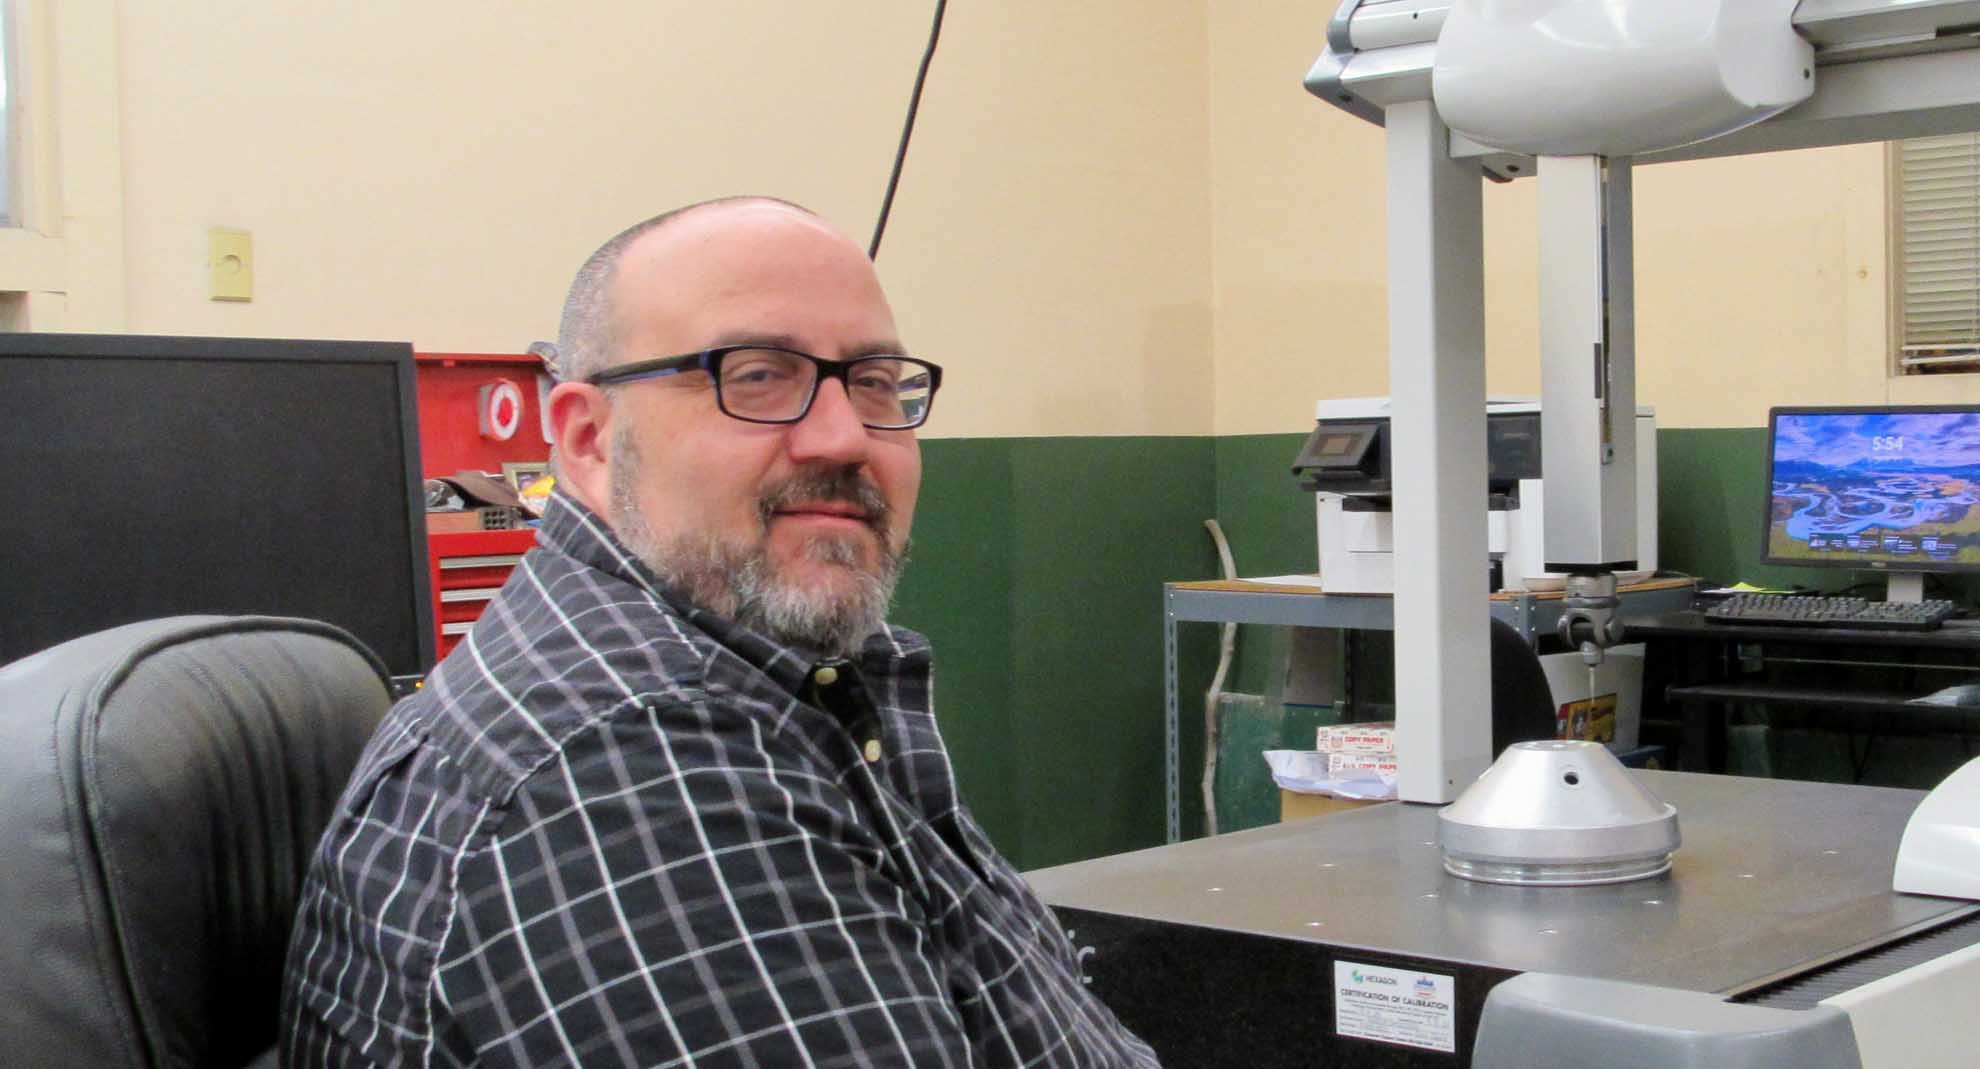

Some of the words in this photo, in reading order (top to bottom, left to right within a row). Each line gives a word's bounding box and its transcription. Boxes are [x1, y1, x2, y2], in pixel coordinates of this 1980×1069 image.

[1872, 436, 1904, 451] 5:54
[1363, 736, 1384, 744] PAPER
[1364, 975, 1398, 986] HEXAGON
[1340, 988, 1389, 1001] CERTIFICATION
[1391, 995, 1401, 1003] OF
[1403, 998, 1449, 1010] CALIBRATION
